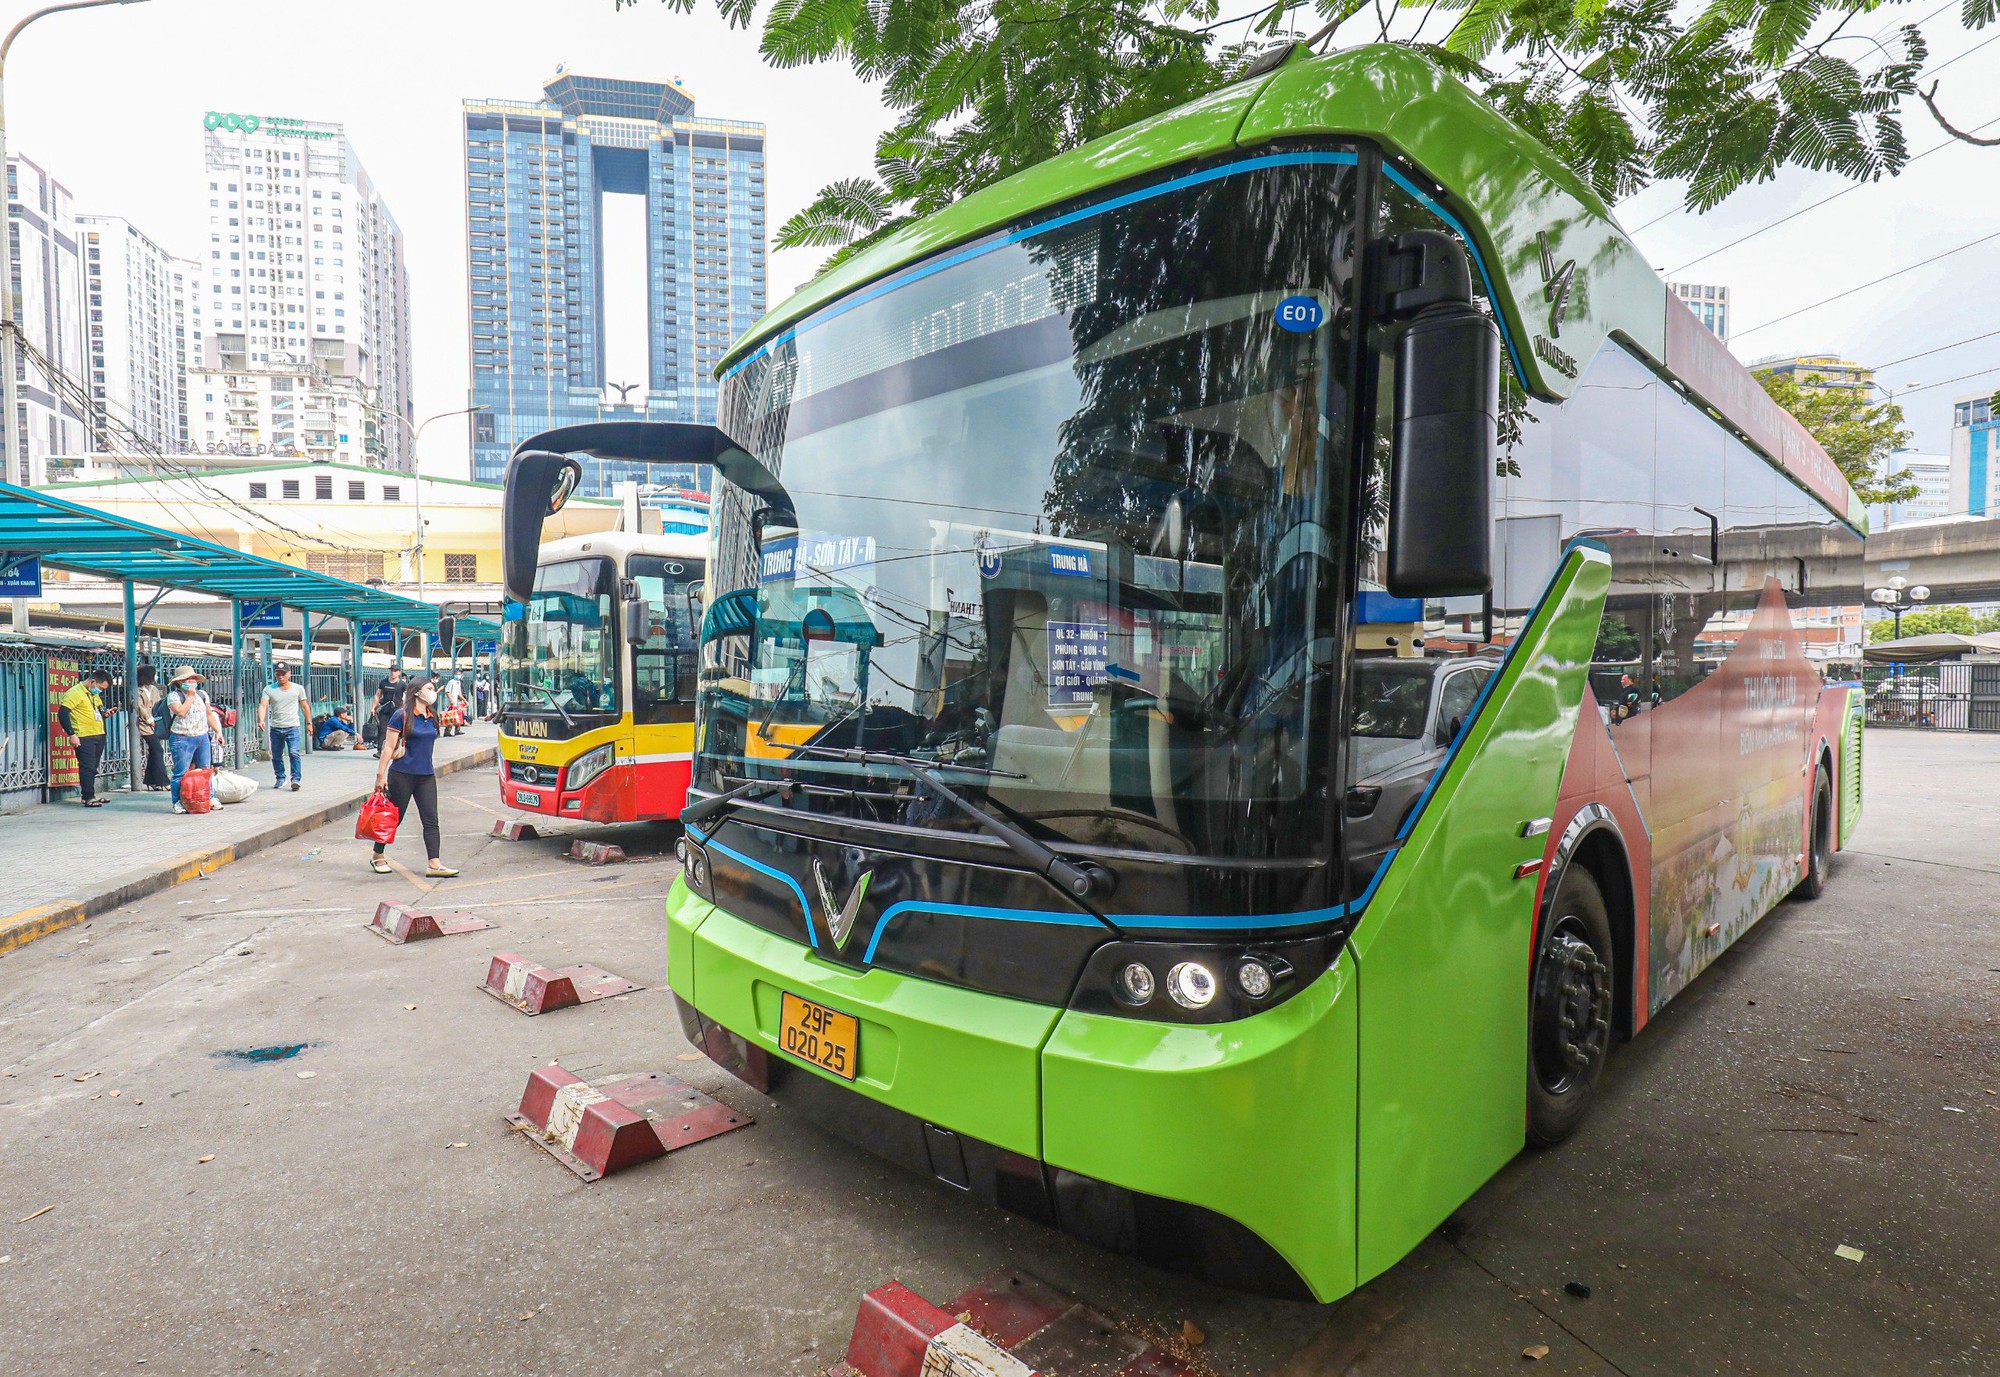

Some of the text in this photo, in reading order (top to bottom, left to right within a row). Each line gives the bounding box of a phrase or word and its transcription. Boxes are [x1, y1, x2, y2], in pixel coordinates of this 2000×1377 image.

[206, 113, 257, 131] FLC
[1283, 305, 1316, 323] E01
[763, 548, 793, 577] TRUNG
[813, 540, 836, 567] SƠN
[838, 536, 860, 565] TÂY
[1051, 553, 1089, 572] TRUNG HÀ
[1056, 628, 1065, 640] QL
[1066, 629, 1075, 640] 32
[801, 1003, 834, 1036] 29F
[787, 1026, 846, 1072] 020.25
